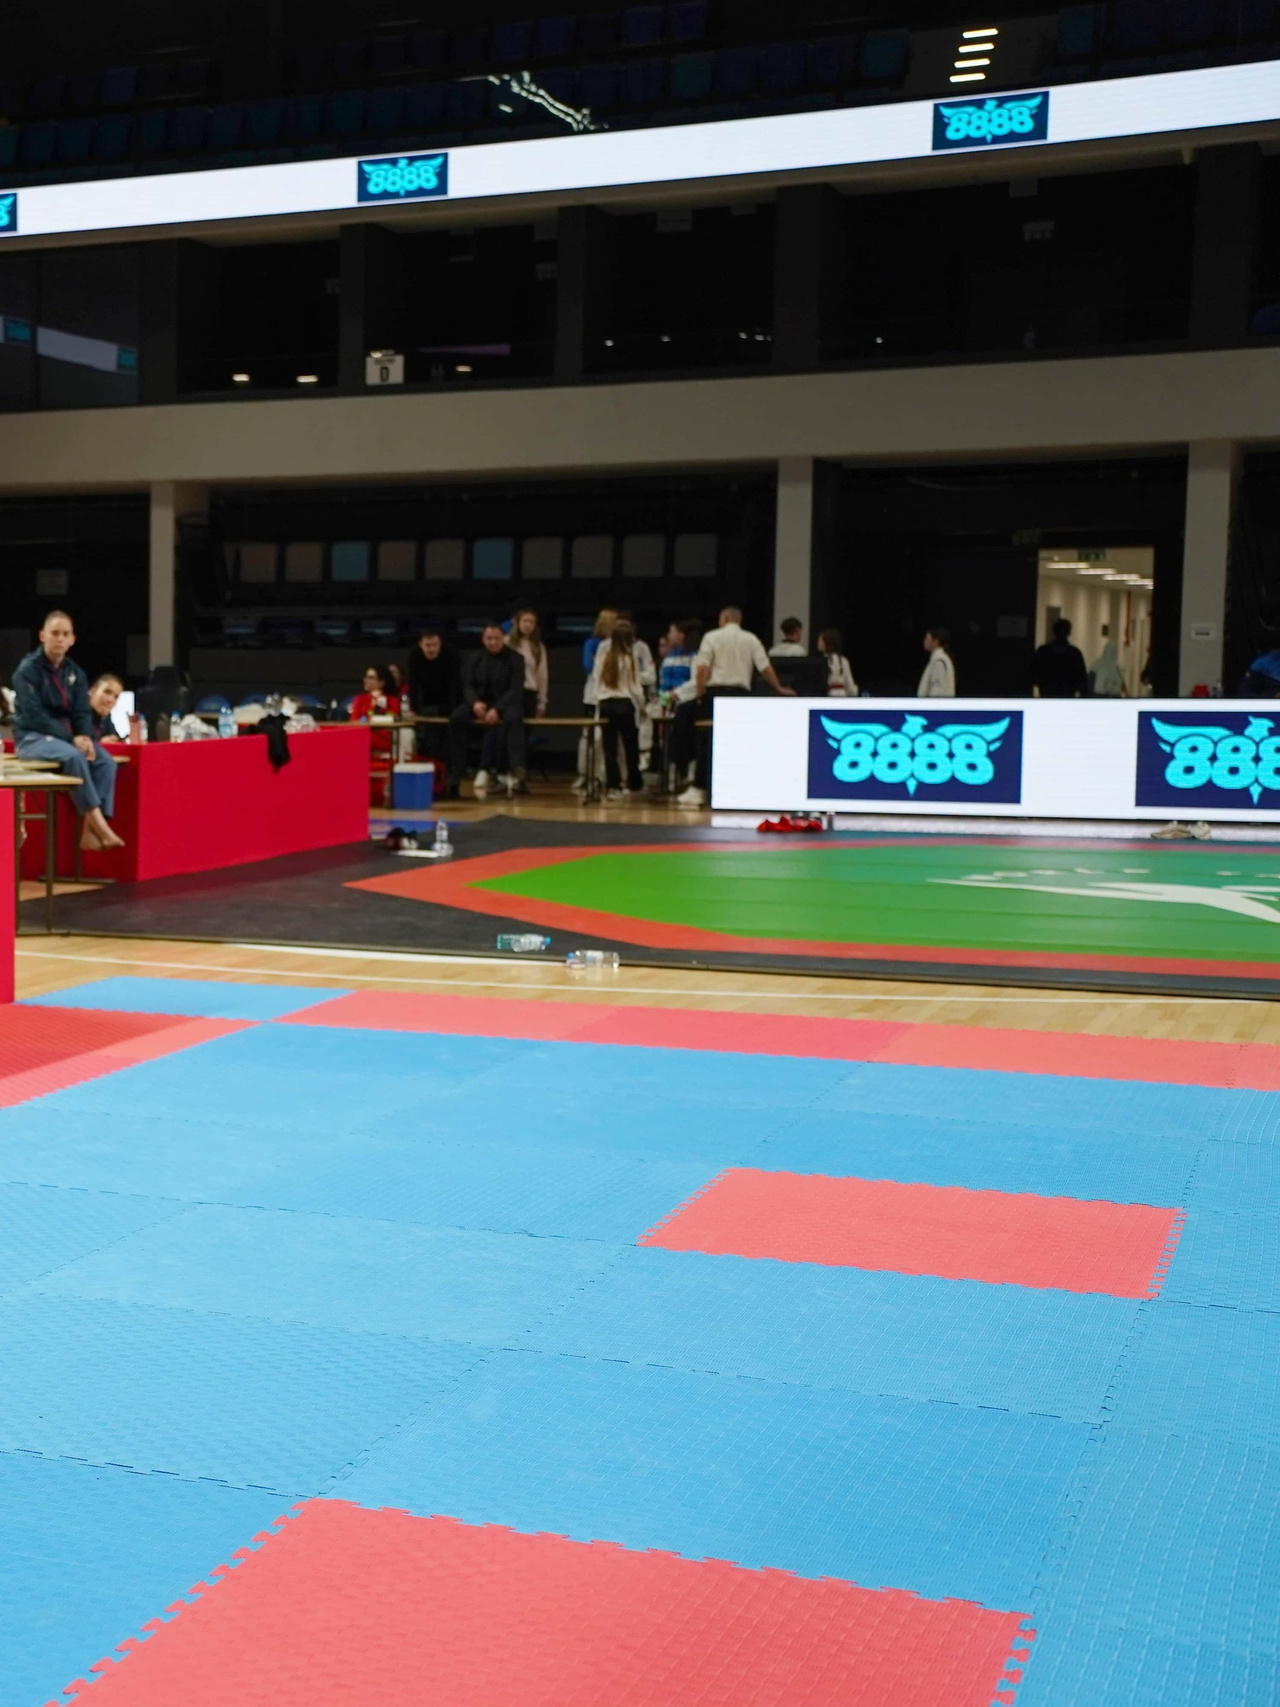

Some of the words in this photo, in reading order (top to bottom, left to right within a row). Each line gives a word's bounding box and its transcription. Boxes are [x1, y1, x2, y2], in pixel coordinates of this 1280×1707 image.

[945, 106, 1034, 140] 8888
[367, 165, 438, 194] 8888
[832, 731, 994, 785] 8888
[1164, 734, 1280, 790] 888
